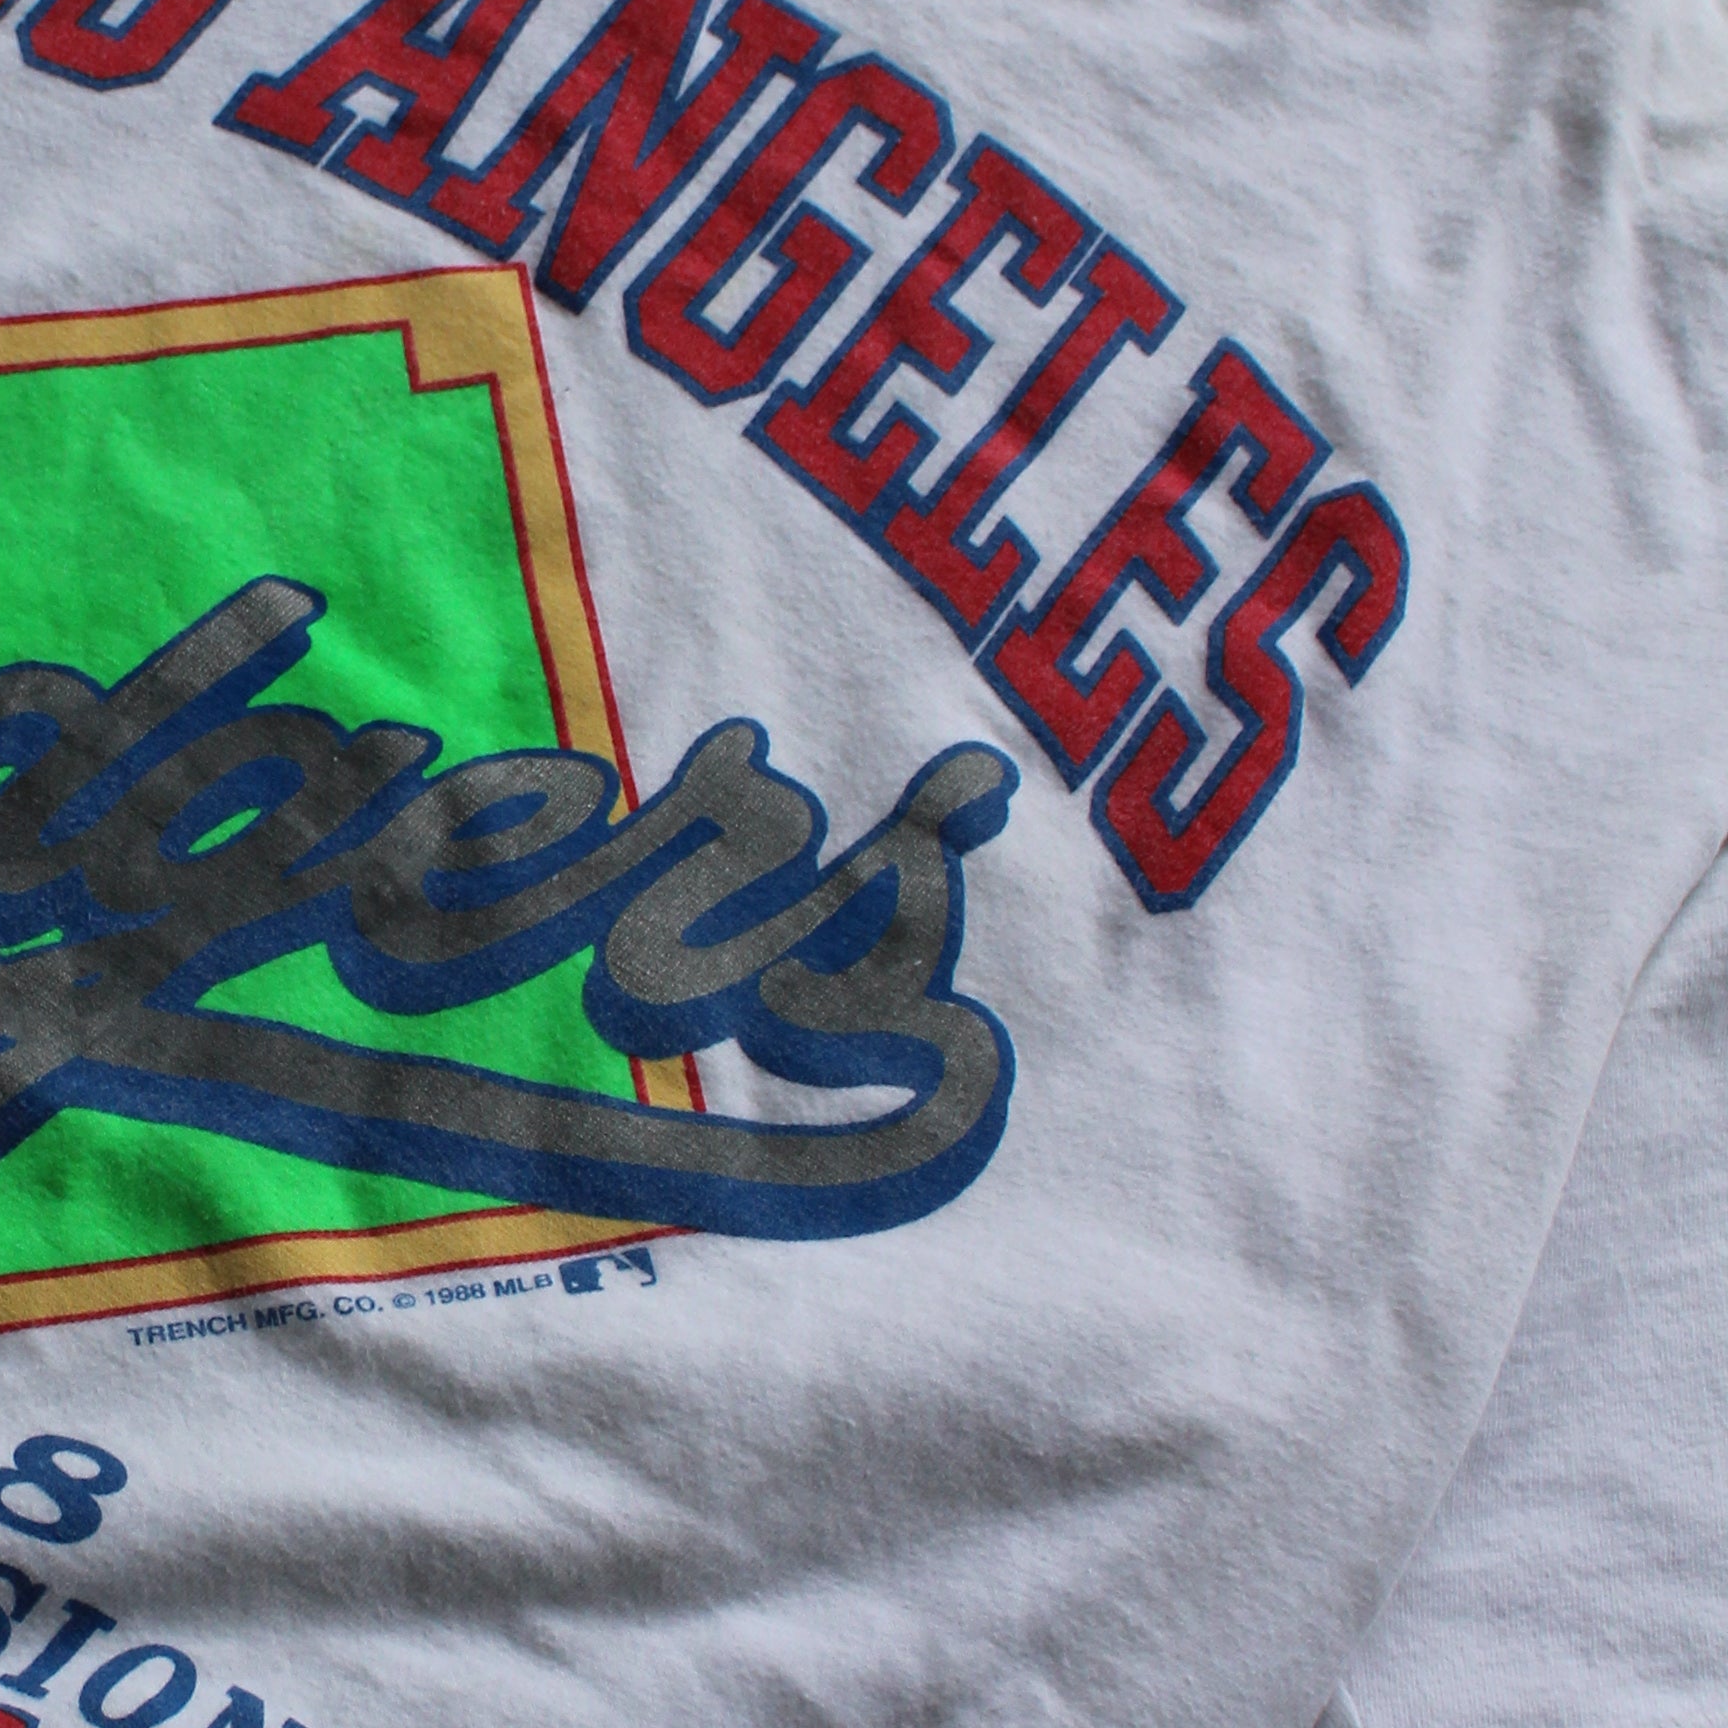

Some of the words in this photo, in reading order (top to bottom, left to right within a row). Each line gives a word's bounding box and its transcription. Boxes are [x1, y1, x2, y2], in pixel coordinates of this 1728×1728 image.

[126, 1311, 249, 1348] TRENCH
[253, 1299, 326, 1330] MFG.
[333, 1294, 384, 1315] CO.
[424, 1281, 488, 1307] 1988
[493, 1271, 554, 1298] MLB
